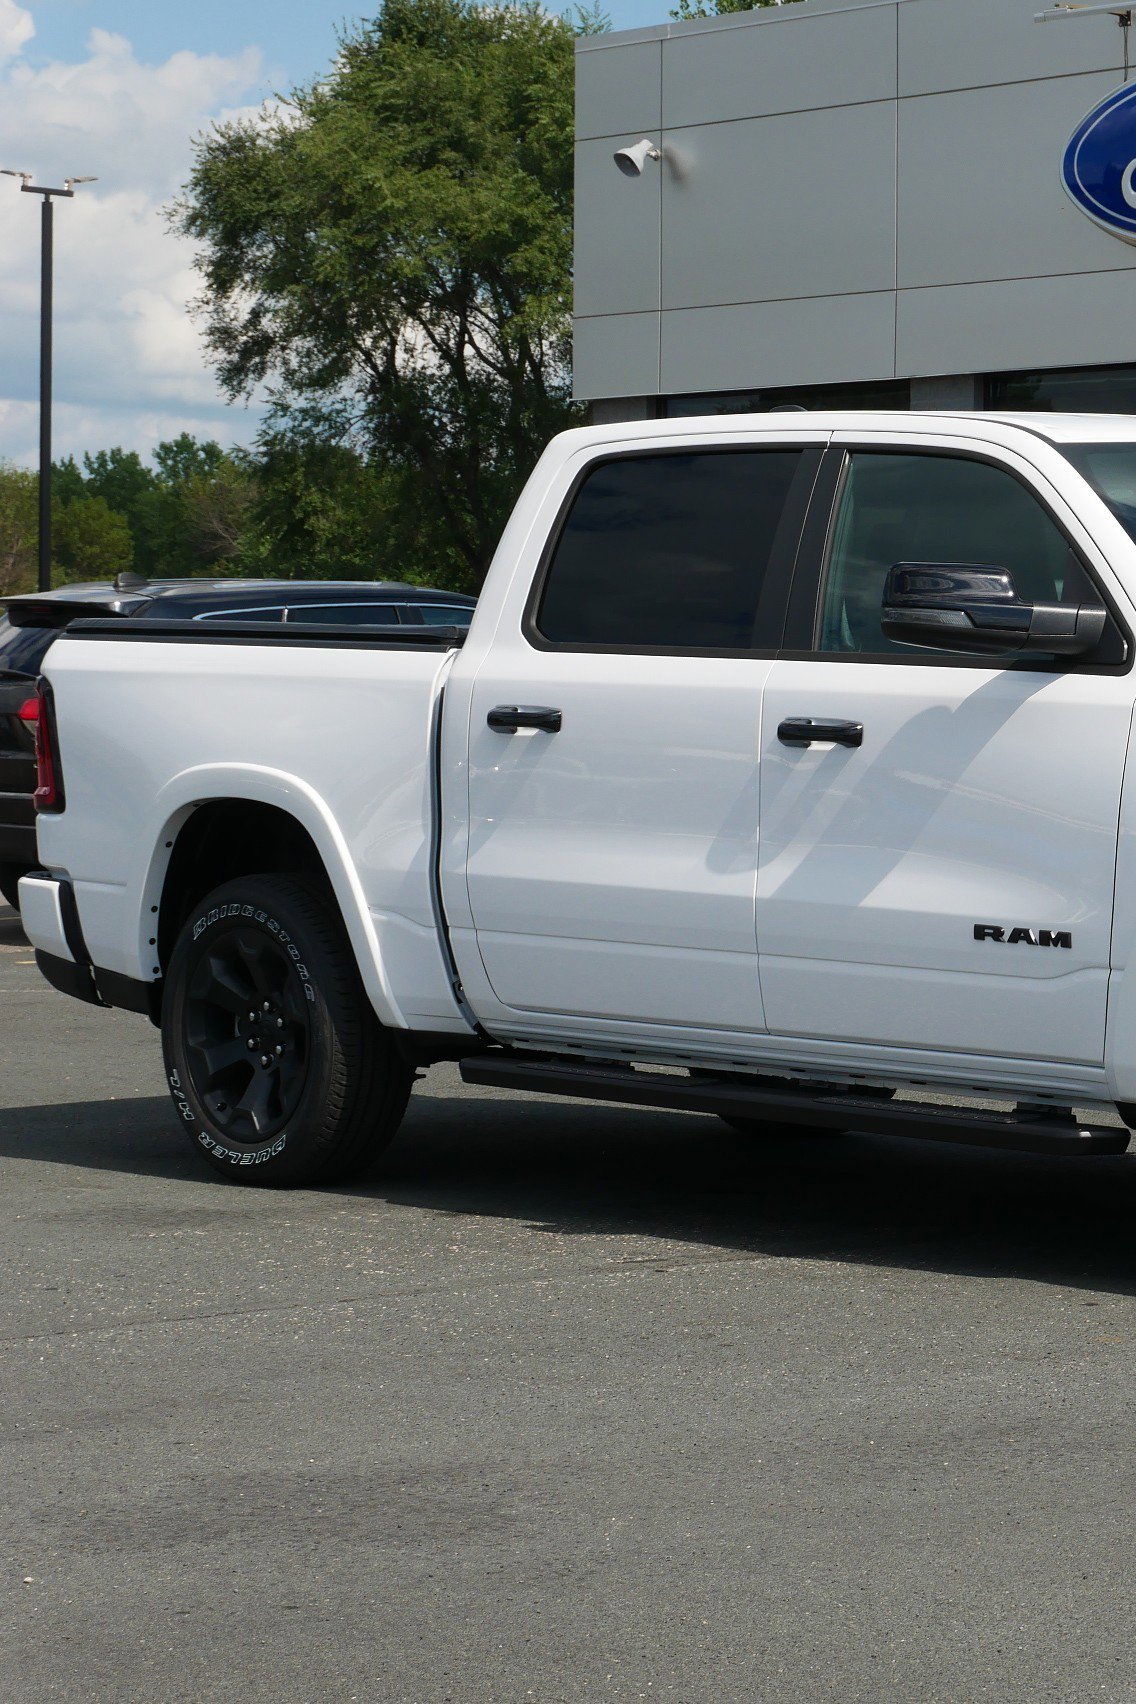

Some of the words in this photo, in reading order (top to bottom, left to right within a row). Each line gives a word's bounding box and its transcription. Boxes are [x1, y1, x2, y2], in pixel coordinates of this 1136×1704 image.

[193, 903, 315, 1001] BRIDGESTONE
[973, 923, 1072, 949] RAM
[169, 1068, 195, 1122] H/L
[198, 1131, 287, 1165] DUELER
